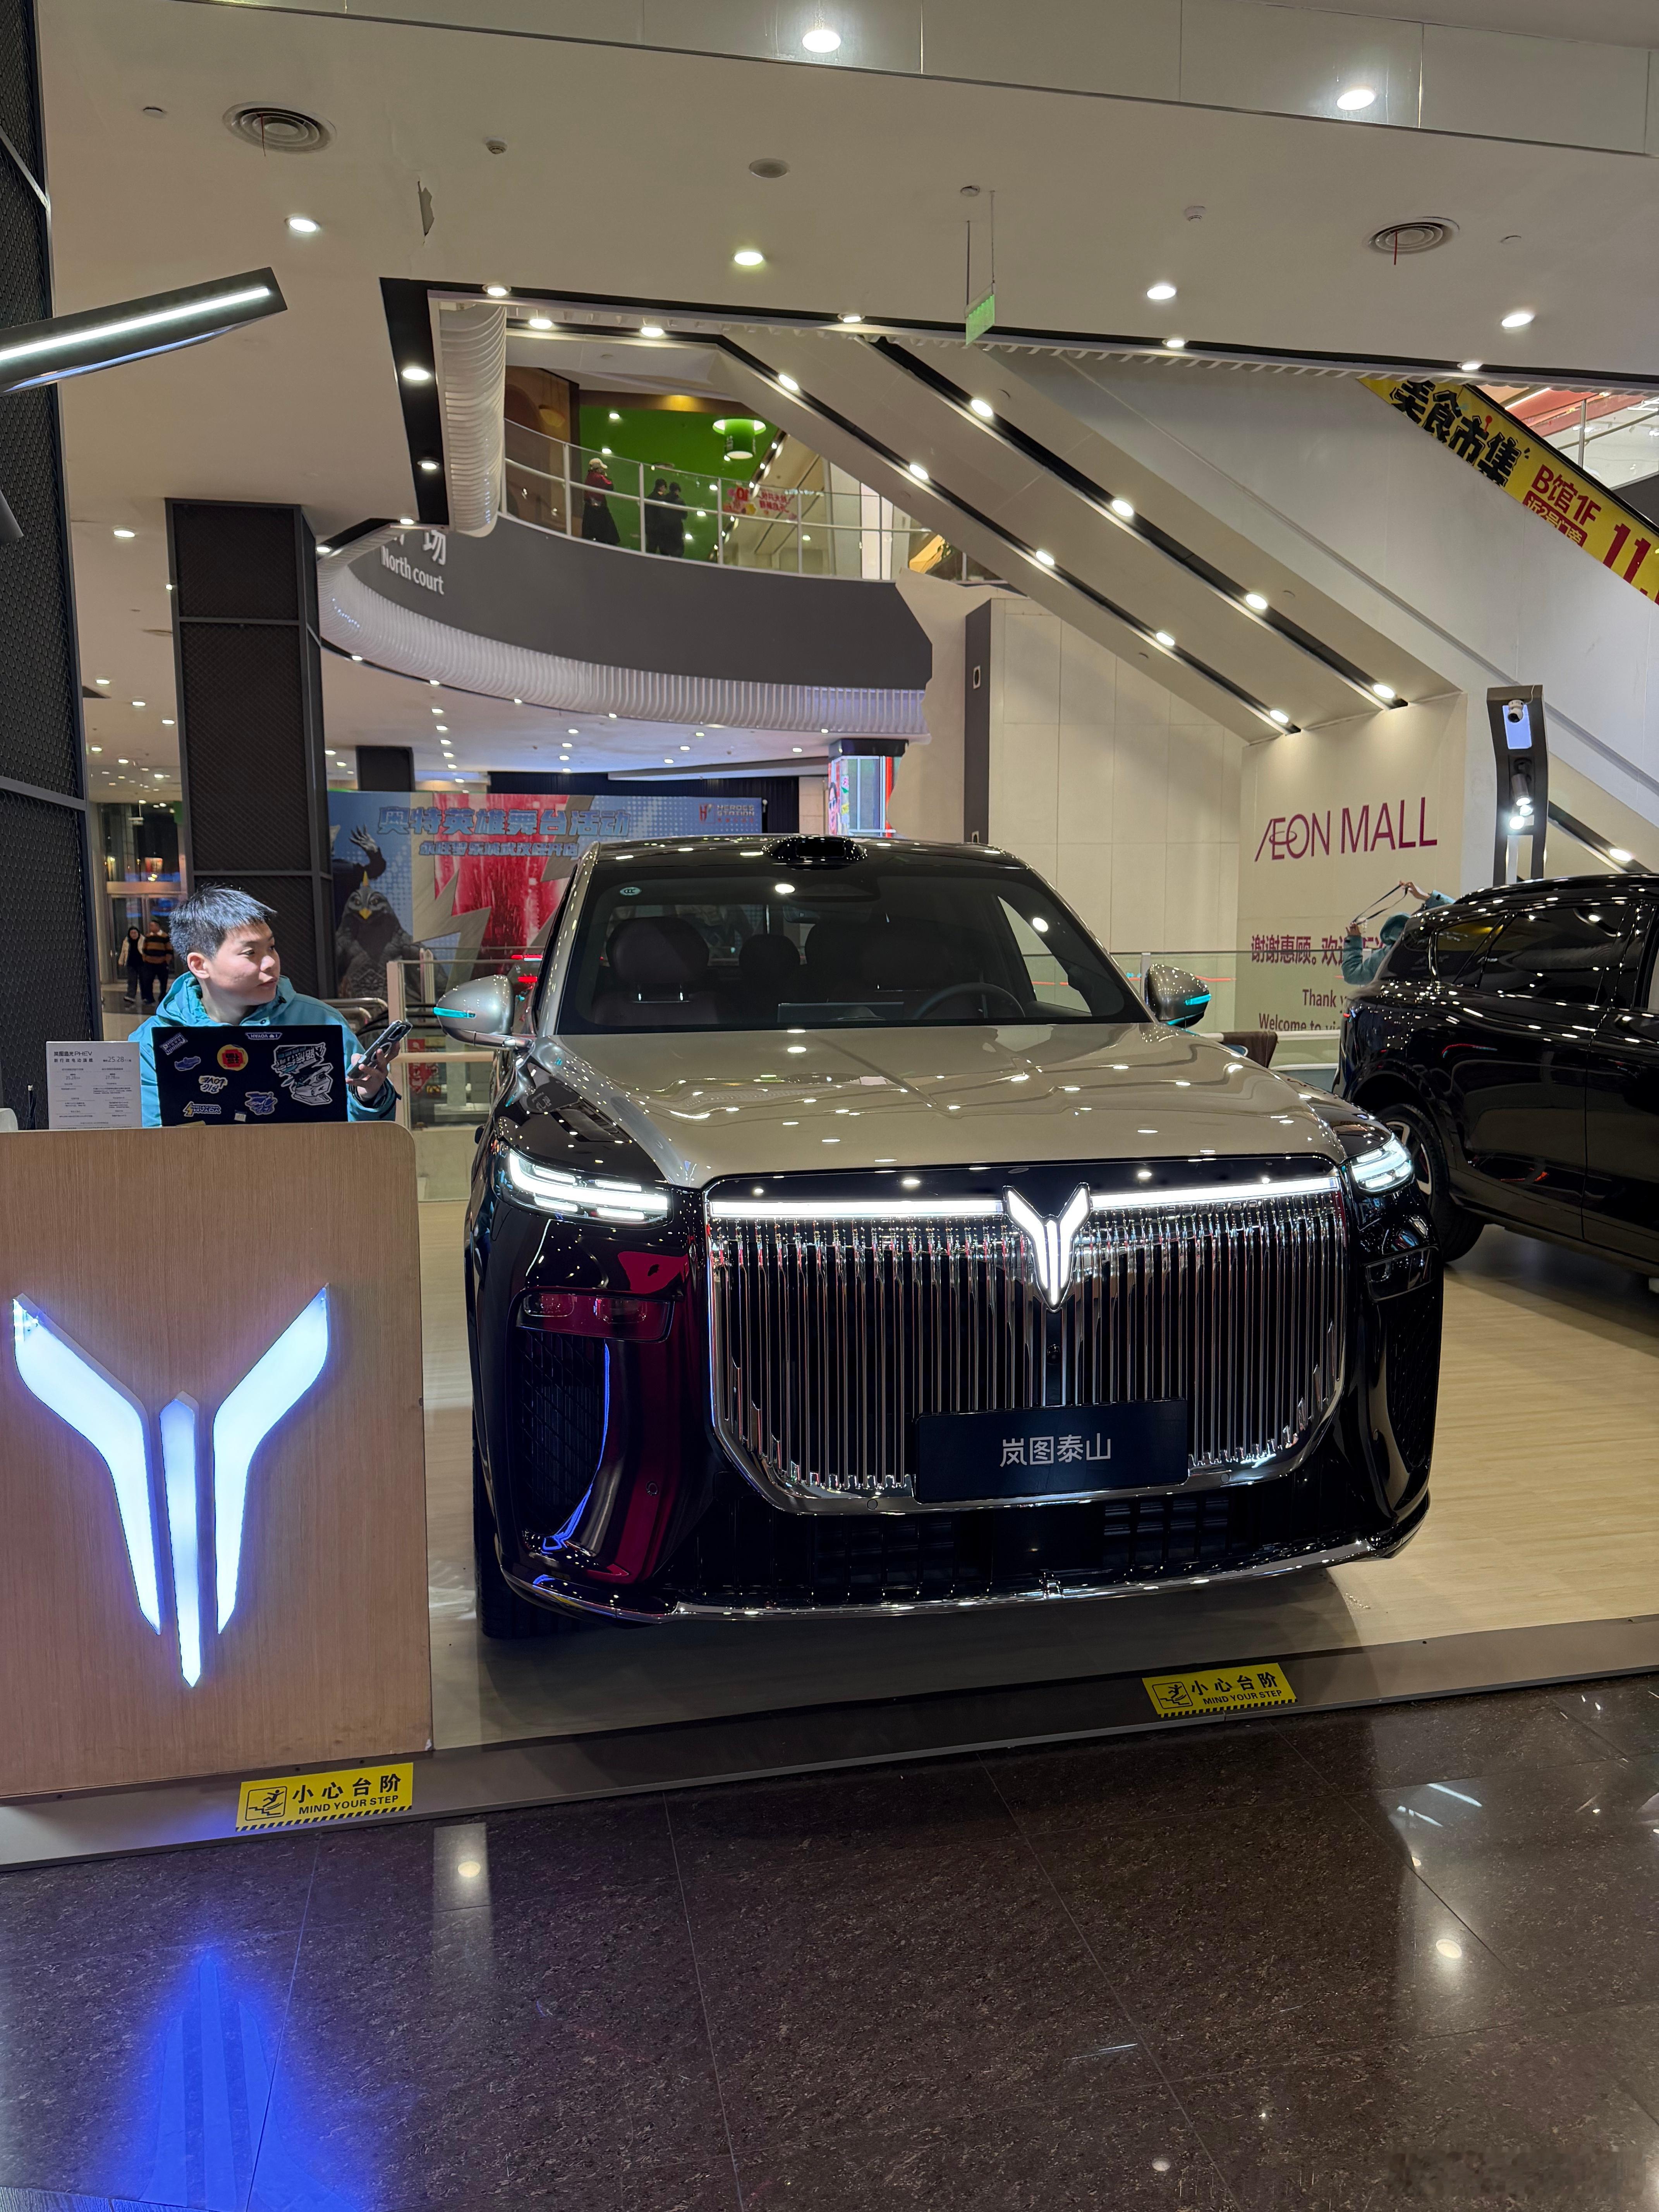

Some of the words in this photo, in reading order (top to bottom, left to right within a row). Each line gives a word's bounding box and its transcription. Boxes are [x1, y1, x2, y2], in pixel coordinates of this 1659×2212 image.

[1389, 380, 1522, 487] 美食市集
[1531, 464, 1601, 526] B馆1F
[381, 545, 412, 580] North
[413, 567, 444, 595] court
[378, 806, 632, 837] 奥特英雄舞台活动
[1341, 797, 1437, 854] MALL
[1302, 989, 1336, 1008] Thank
[1259, 1013, 1306, 1031] Welcome
[201, 1077, 225, 1088] LOVE
[202, 1084, 219, 1093] BIG
[1000, 1433, 1111, 1467] 岚图泰山
[1192, 1672, 1278, 1696] 小心台阶
[1203, 1695, 1229, 1705] MIND
[1230, 1693, 1258, 1702] YOUR
[1259, 1689, 1282, 1698] STEP
[292, 1773, 401, 1803] 小心台阶
[299, 1803, 330, 1815] MIND
[334, 1799, 367, 1810] YOUR
[369, 1795, 399, 1805] STEP
